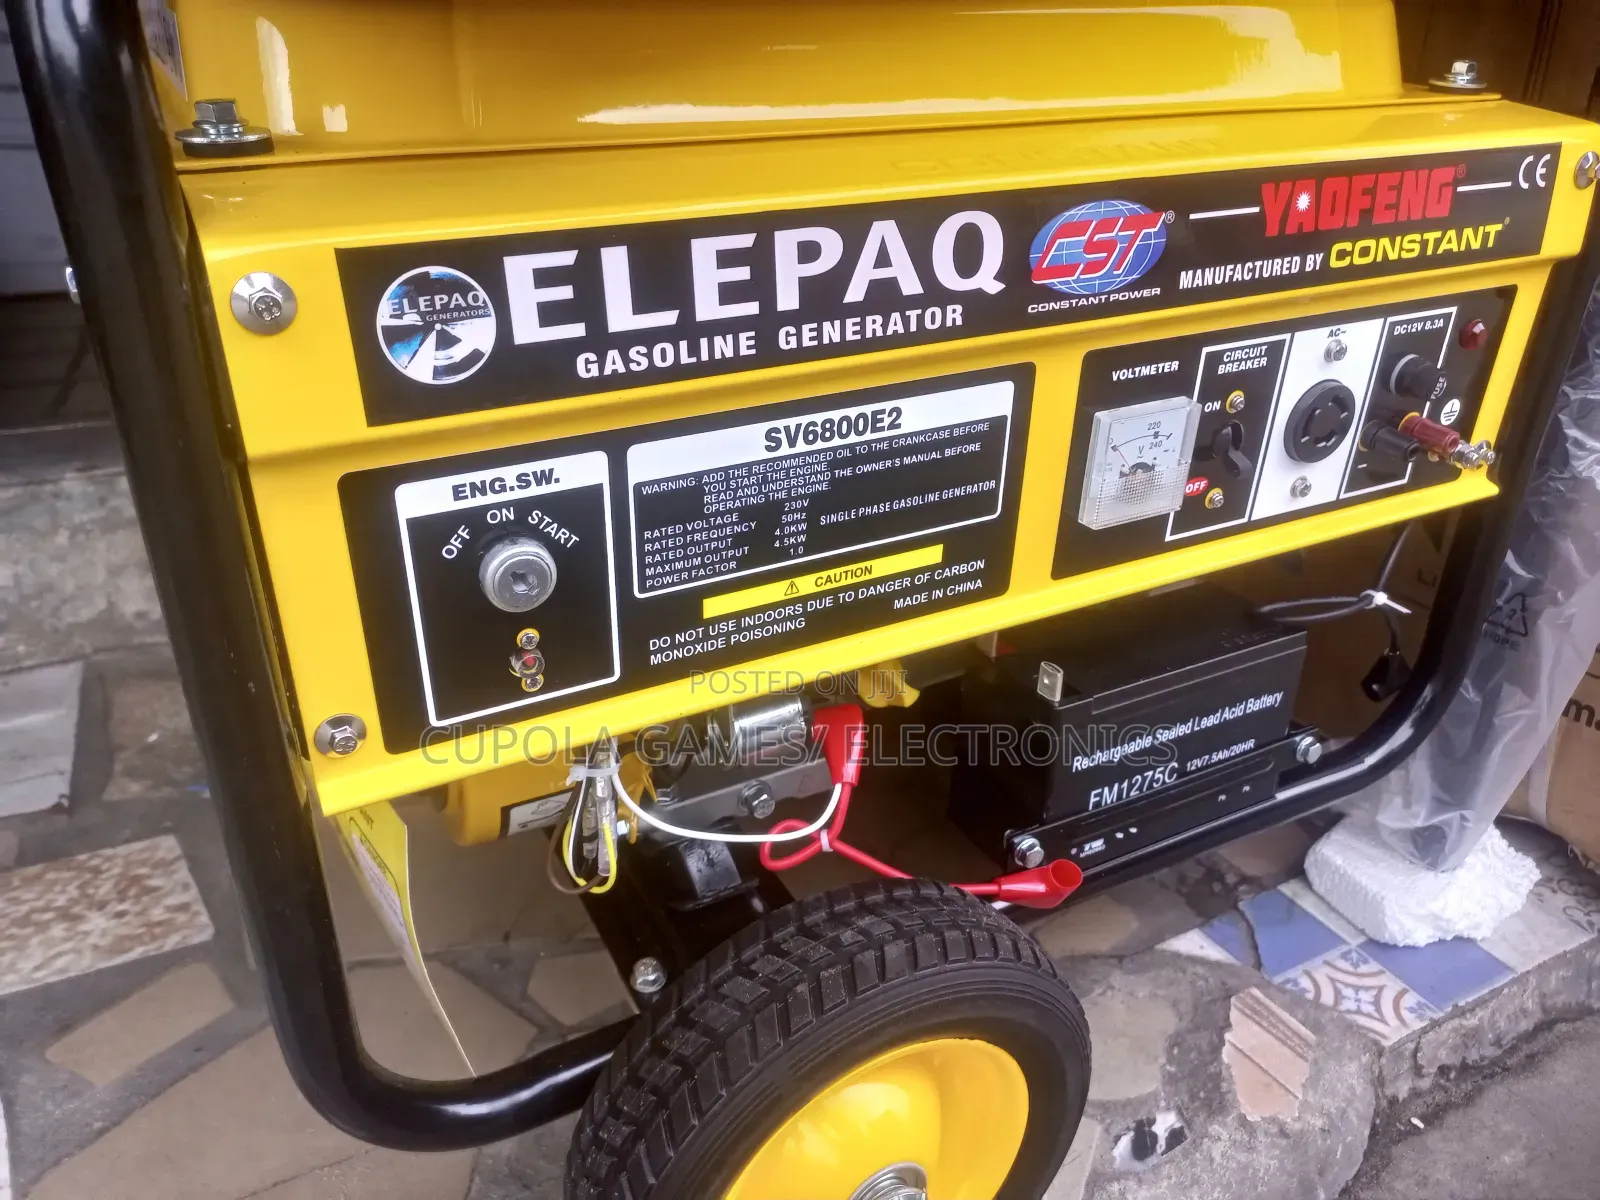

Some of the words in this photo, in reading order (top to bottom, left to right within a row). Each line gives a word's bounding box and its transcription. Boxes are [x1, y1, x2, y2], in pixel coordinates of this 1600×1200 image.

[1518, 153, 1551, 190] CE
[1261, 166, 1456, 237] YAOFENG
[1031, 211, 1166, 284] CST
[1179, 255, 1300, 290] MANUFACTURED
[1305, 252, 1324, 272] BY
[1329, 223, 1503, 269] CONSTANT
[503, 210, 1007, 346] ELEPAQ
[387, 290, 485, 316] ELEPAQ
[426, 308, 491, 322] GENERATORS
[1027, 295, 1110, 313] CONSTANT
[1110, 287, 1161, 302] POWER
[576, 331, 757, 379] GASOLINE
[778, 303, 964, 351] GENERATOR
[1393, 322, 1423, 336] DC12V
[1424, 318, 1444, 330] 8.3A
[1112, 360, 1180, 382] VOLTMETER
[1217, 356, 1268, 375] BREAKER
[1223, 345, 1268, 362] CIRCUIT
[1204, 400, 1222, 413] ON
[1430, 376, 1446, 400] FUSE
[764, 406, 903, 453] SV6800E2
[1147, 421, 1161, 431] 220
[1149, 440, 1163, 449] 240
[641, 476, 699, 495] WARNING:
[702, 472, 725, 485] ADD
[728, 466, 749, 479] THE
[752, 451, 834, 474] RECOMMENDED
[837, 448, 852, 458] OIL
[855, 445, 869, 455] TO
[871, 441, 890, 452] THE
[892, 429, 951, 448] CRANKCASE
[953, 422, 990, 437] BEFORE
[704, 491, 734, 504] READ
[736, 486, 759, 498] AND
[762, 471, 832, 493] UNDERSTAND
[834, 467, 853, 479] THE
[856, 458, 901, 474] OWNER'S
[903, 451, 943, 465] MANUAL
[944, 442, 982, 457] BEFORE
[452, 468, 561, 501] ENG.SW.
[703, 482, 727, 494] YOU
[730, 475, 763, 489] START
[766, 470, 788, 482] THE
[790, 462, 831, 478] ENGINE.
[1185, 480, 1208, 493] OFF
[486, 506, 515, 524] ON
[703, 495, 765, 514] OPERATING
[768, 490, 789, 502] THE
[791, 481, 832, 497] ENGINE.
[820, 508, 857, 526] SINGLE
[858, 502, 891, 518] PHASE
[893, 491, 940, 510] GASOLINE
[942, 479, 997, 500] GENERATOR
[527, 509, 580, 549] START
[644, 524, 684, 540] RATED
[686, 512, 740, 531] VOLTAGE
[784, 498, 810, 511] 230V
[644, 536, 684, 552] RATED
[686, 521, 757, 544] FREQUENCY
[781, 512, 807, 524] 50Hz
[441, 524, 472, 560] OFF
[645, 548, 684, 565] RATED
[686, 538, 733, 555] OUTPUT
[774, 522, 808, 536] 4.0KW
[645, 556, 702, 577] MAXIMUM
[704, 546, 750, 563] OUTPUT
[774, 534, 807, 548] 4.5KW
[646, 571, 689, 589] POWER
[691, 561, 737, 578] FACTOR
[789, 546, 804, 556] 1.0
[814, 564, 873, 588] CAUTION
[649, 636, 671, 651] DO
[675, 627, 705, 645] NOT
[709, 619, 737, 636] USE
[741, 603, 803, 628] INDOORS
[807, 596, 834, 612] DUE
[838, 591, 855, 604] TO
[858, 577, 911, 600] DANGER
[914, 572, 932, 585] OF
[934, 558, 985, 580] CARBON
[894, 593, 929, 610] MADE
[932, 589, 943, 600] IN
[947, 578, 983, 596] CHINA
[650, 637, 727, 666] MONOXIDE
[730, 617, 806, 646] POISONING
[1072, 733, 1154, 774] Rechargeable
[1154, 718, 1193, 744] Sealed
[1193, 709, 1221, 732] Lead
[1221, 701, 1245, 723] Acid
[1245, 690, 1284, 714] Battery
[1088, 762, 1179, 811] FM1275C
[1186, 738, 1256, 772] 12V7.5Ah/20HR
